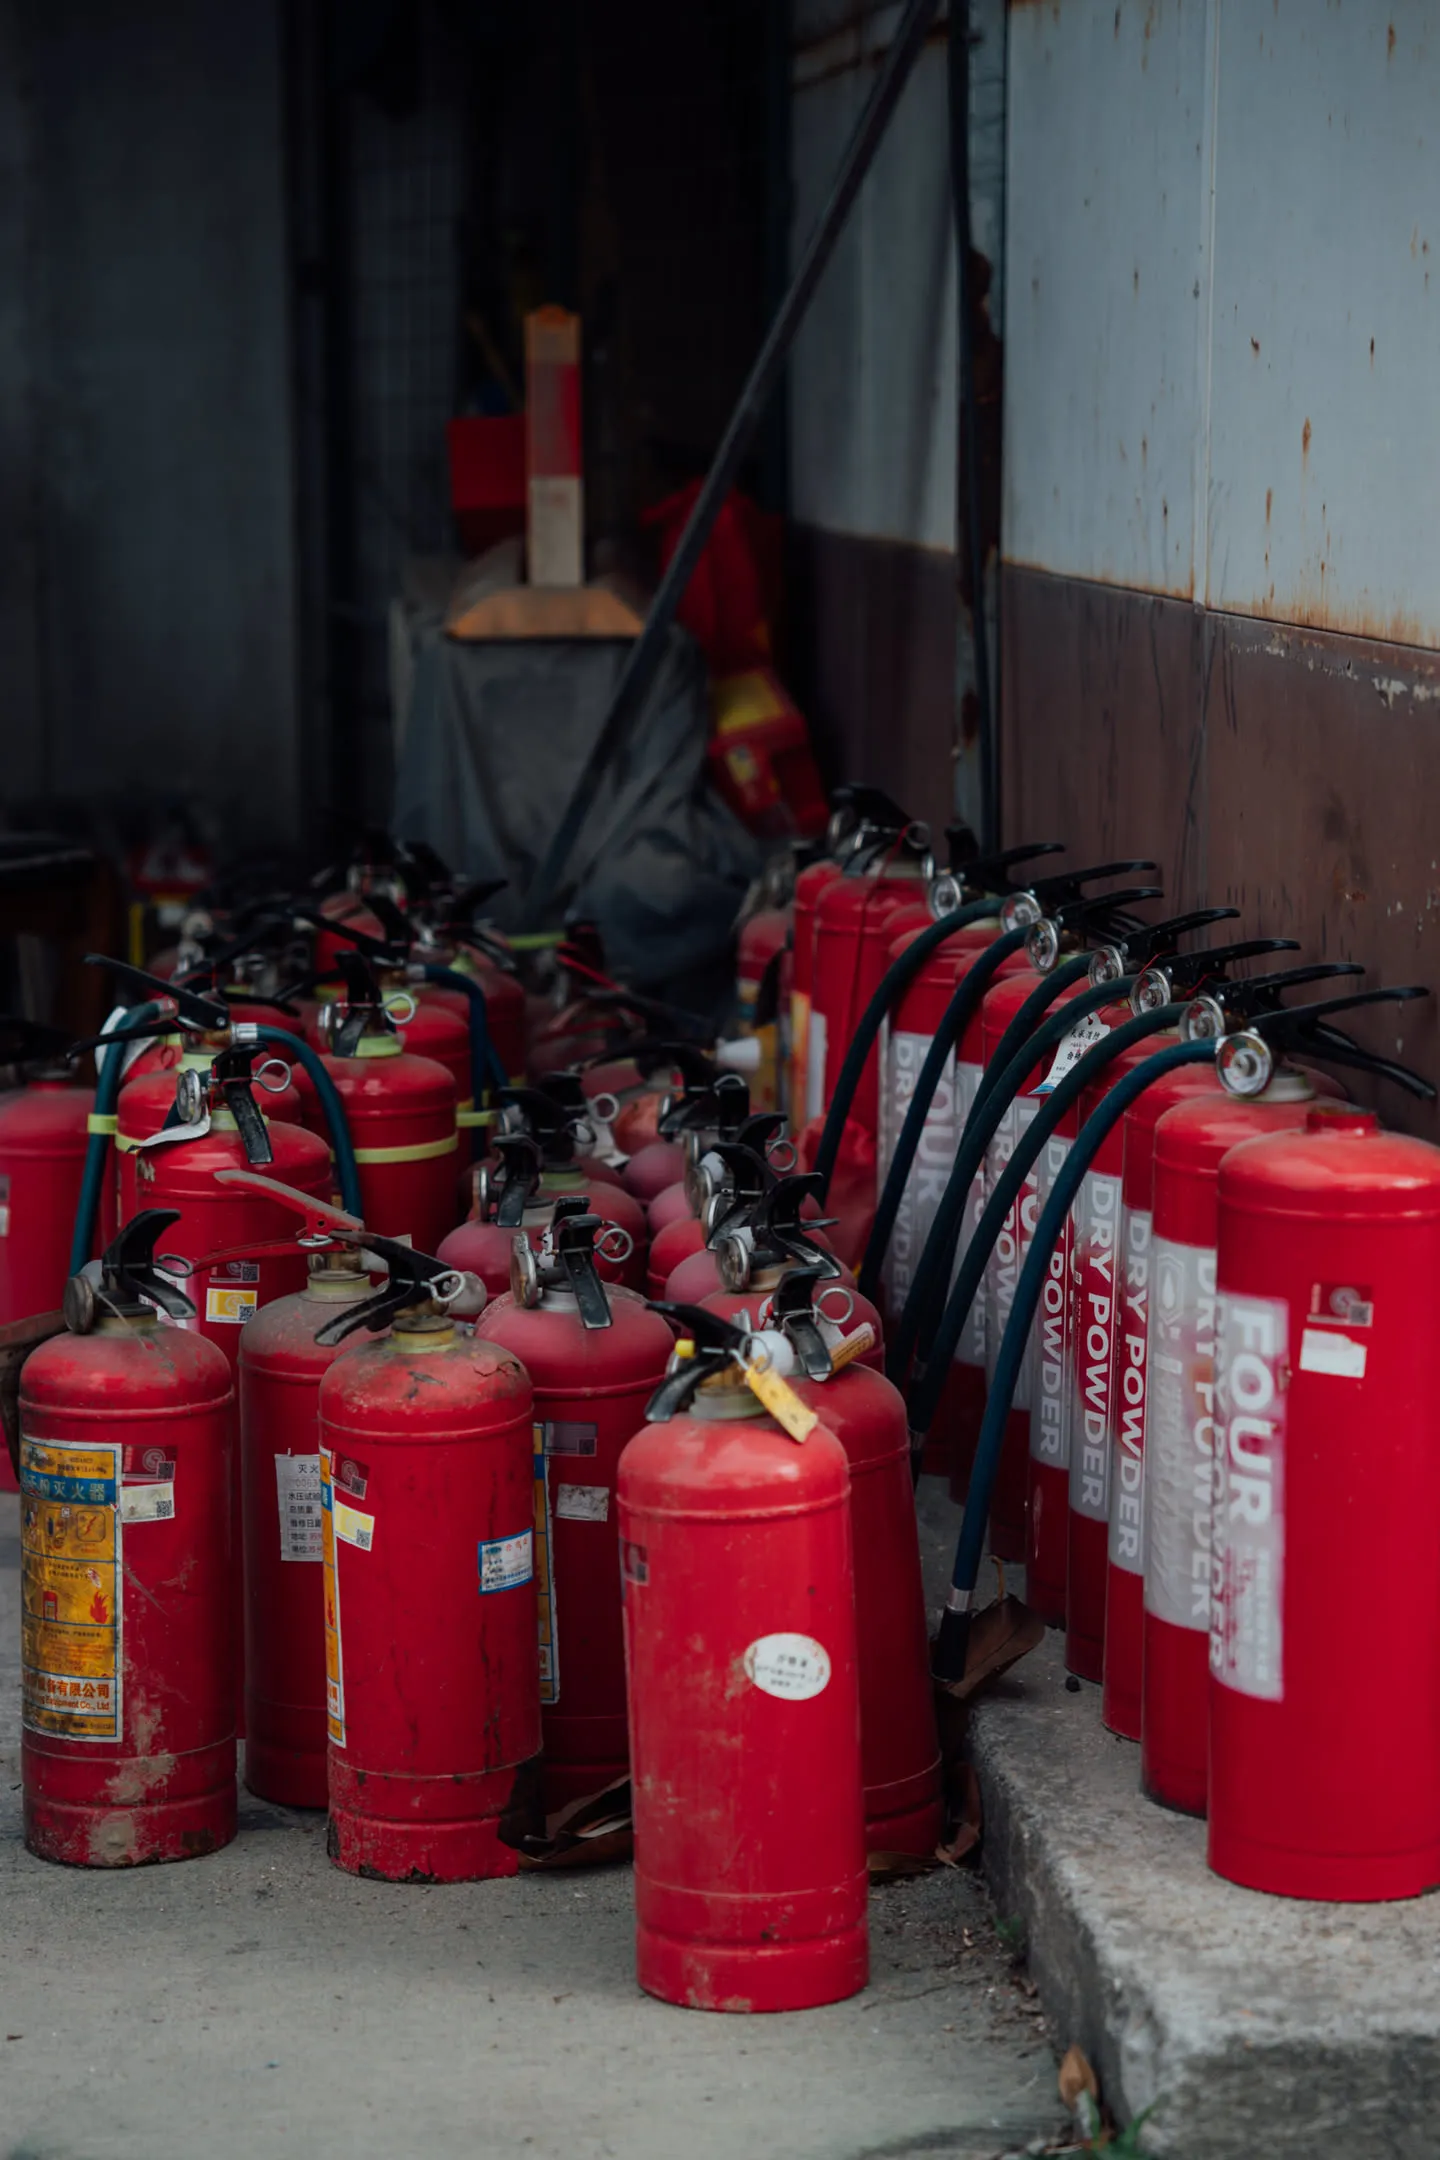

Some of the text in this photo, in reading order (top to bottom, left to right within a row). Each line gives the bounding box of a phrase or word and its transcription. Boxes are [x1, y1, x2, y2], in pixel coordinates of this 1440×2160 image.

[1081, 1181, 1115, 1508] DRY POWDER
[1117, 1216, 1150, 1559] DRY POWDER
[1229, 1308, 1275, 1523] FOUR
